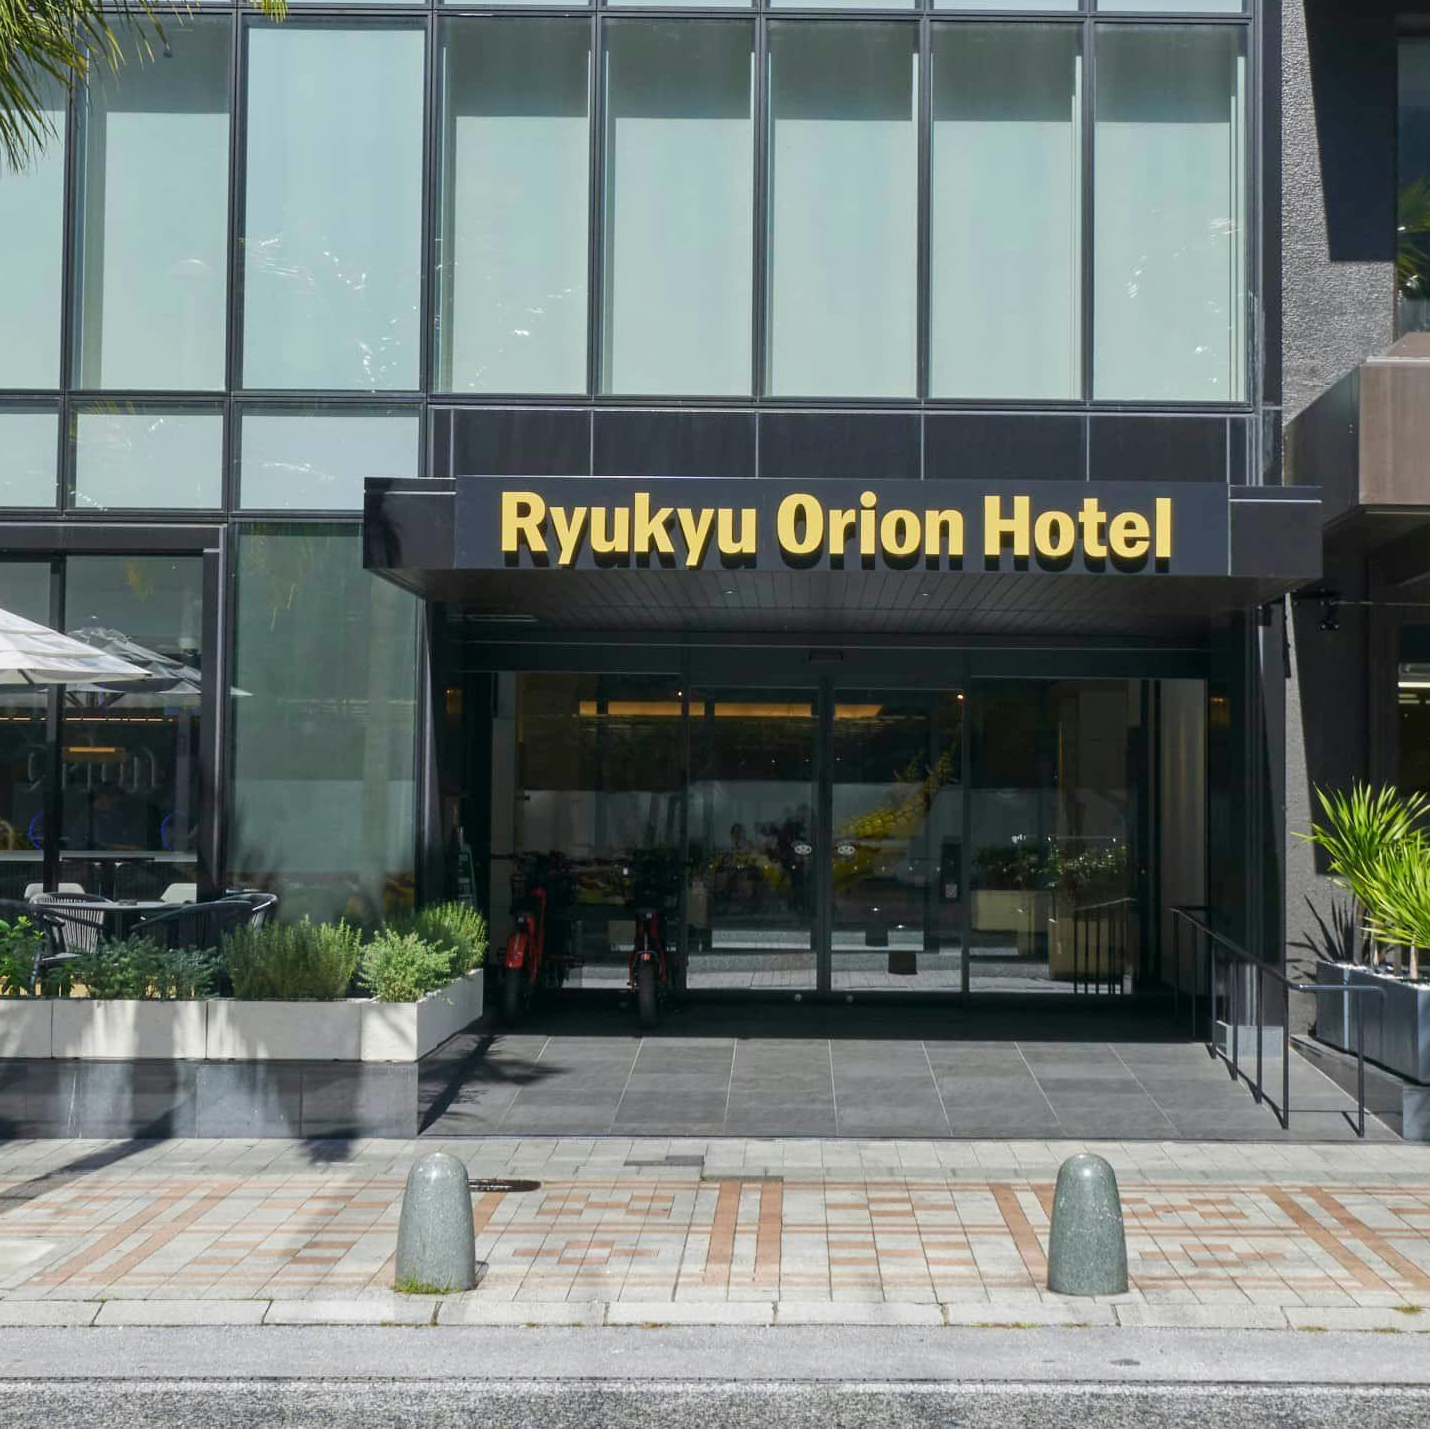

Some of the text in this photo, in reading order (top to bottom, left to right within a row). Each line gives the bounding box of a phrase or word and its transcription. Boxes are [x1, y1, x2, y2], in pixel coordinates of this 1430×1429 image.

[501, 490, 1172, 566] Ryukyu Orion Hotel
